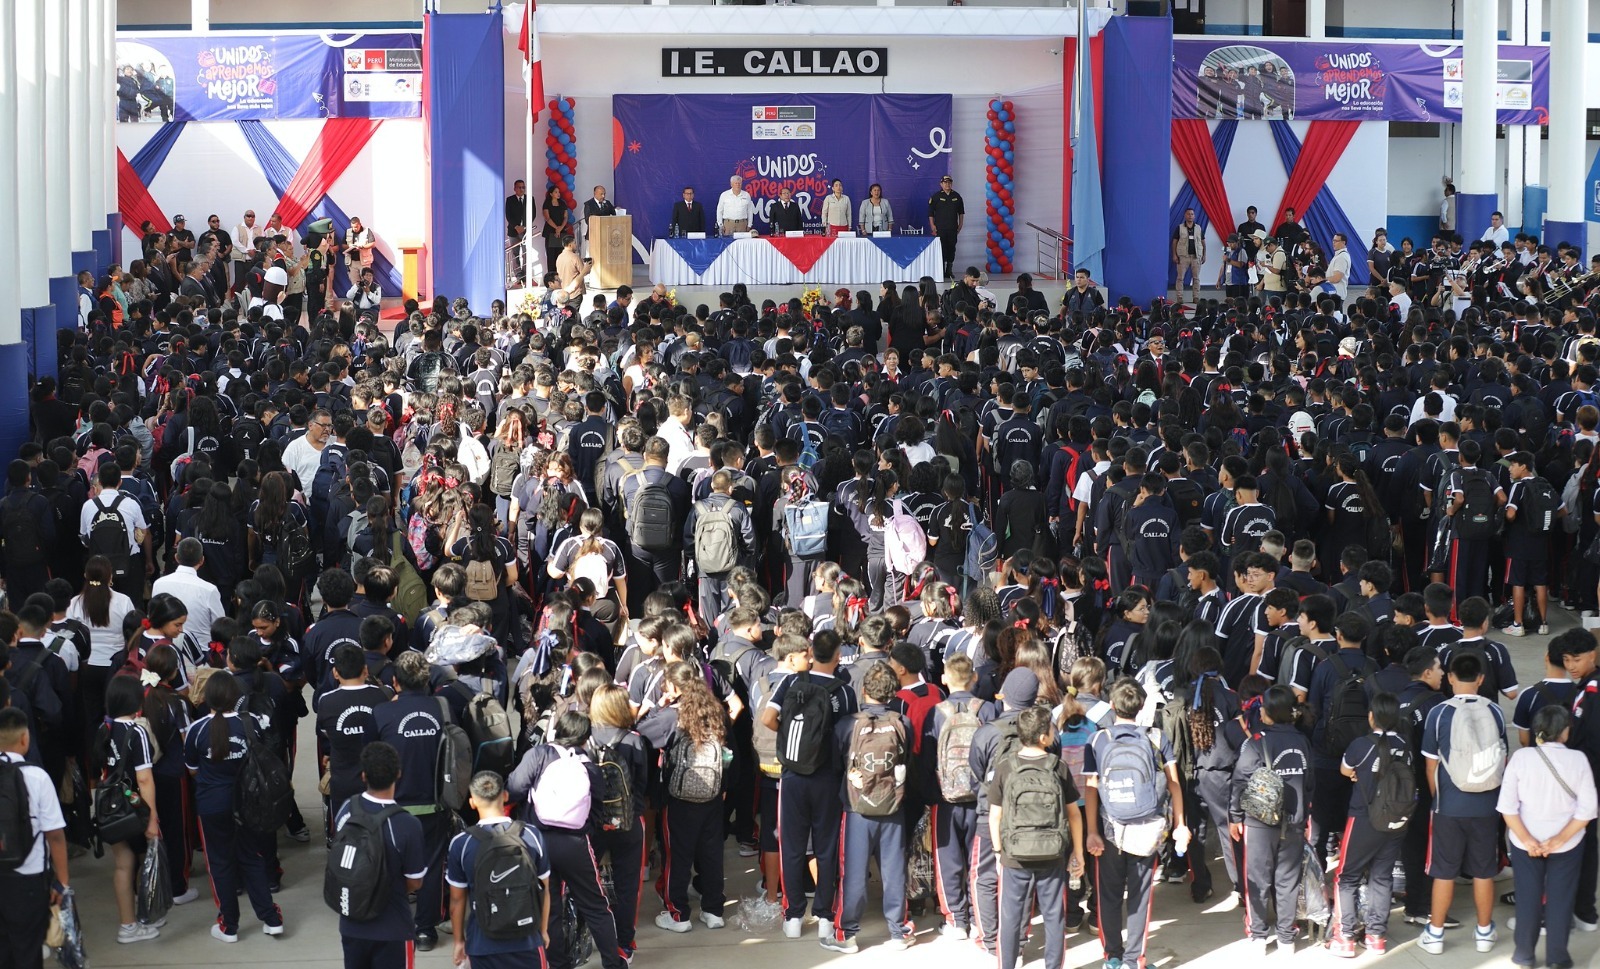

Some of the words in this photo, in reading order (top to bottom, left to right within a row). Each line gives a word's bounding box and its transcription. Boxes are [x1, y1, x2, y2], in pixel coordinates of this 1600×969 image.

[670, 51, 725, 74] I.E.
[743, 50, 880, 74] CALLAO
[343, 726, 365, 736] CALL
[403, 729, 437, 738] CALLAO
[1275, 767, 1304, 776] CALLA
[340, 887, 349, 916] adidas
